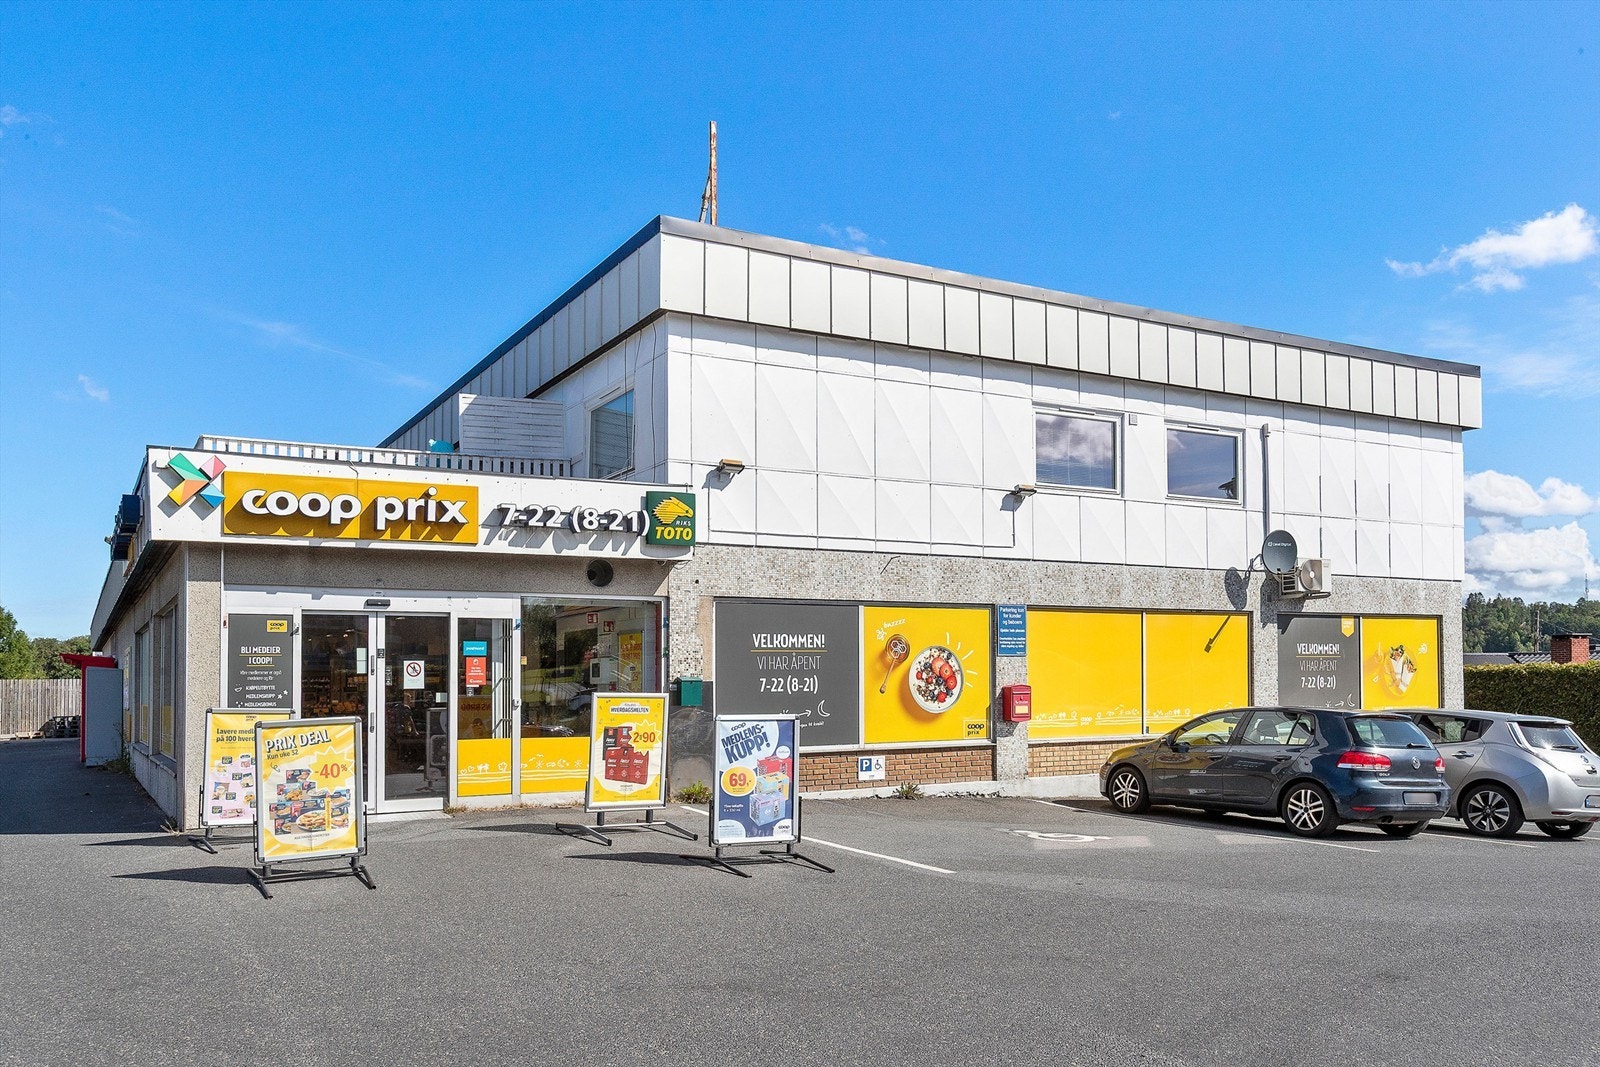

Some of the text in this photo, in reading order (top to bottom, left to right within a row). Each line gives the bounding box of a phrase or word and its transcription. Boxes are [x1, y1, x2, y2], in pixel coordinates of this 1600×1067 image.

[242, 486, 468, 530] coop prix
[498, 503, 650, 537] 7-22 (8-21)
[655, 526, 693, 541] TOTO
[752, 633, 825, 648] VELKOMMEN!
[240, 646, 281, 654] BLI MEDEIER
[1296, 643, 1340, 655] VELKOMMEN!
[757, 652, 821, 670] VI HAR ÅPENT
[1300, 657, 1337, 671] VI HAR ÅPENT
[759, 674, 819, 695] 7-22 (8-21)
[1301, 674, 1336, 690] 7-22 (8-21)
[731, 722, 746, 732] coop
[967, 722, 985, 730] coop
[967, 728, 980, 736] prix
[216, 735, 225, 743] på
[265, 729, 331, 753] PRIX DEAL
[721, 723, 765, 749] MEDLEMS-
[724, 731, 771, 765] KUPP!
[863, 760, 870, 771] P
